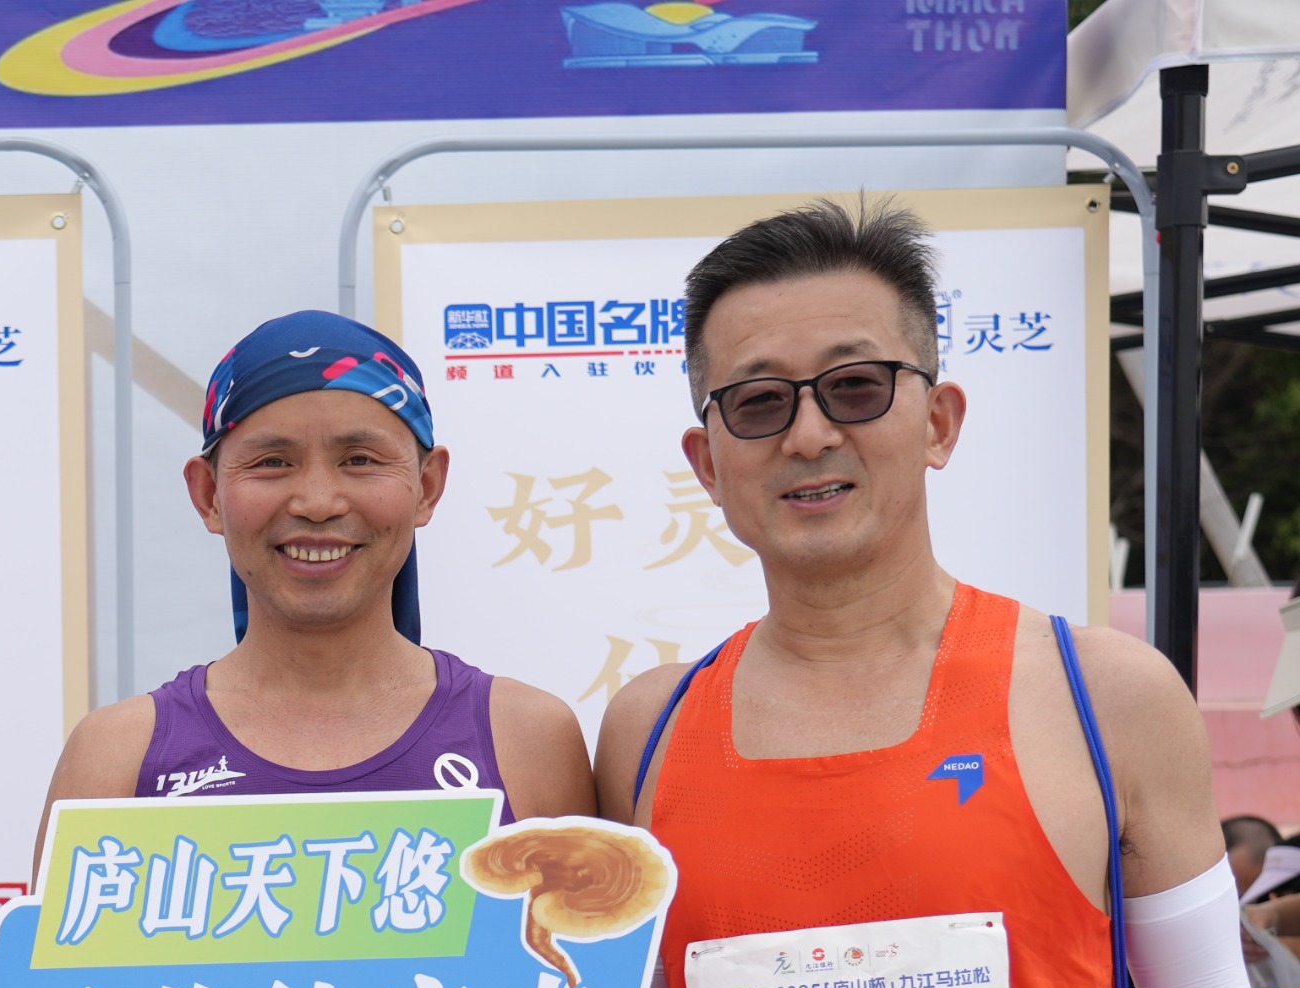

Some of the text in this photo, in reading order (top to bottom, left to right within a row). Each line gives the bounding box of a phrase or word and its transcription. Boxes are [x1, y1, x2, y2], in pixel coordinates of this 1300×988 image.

[964, 312, 1054, 355] 灵芝
[446, 361, 687, 380] 频道入驻伙
[943, 761, 979, 771] NEDAO
[56, 827, 452, 943] 庐山天下悠
